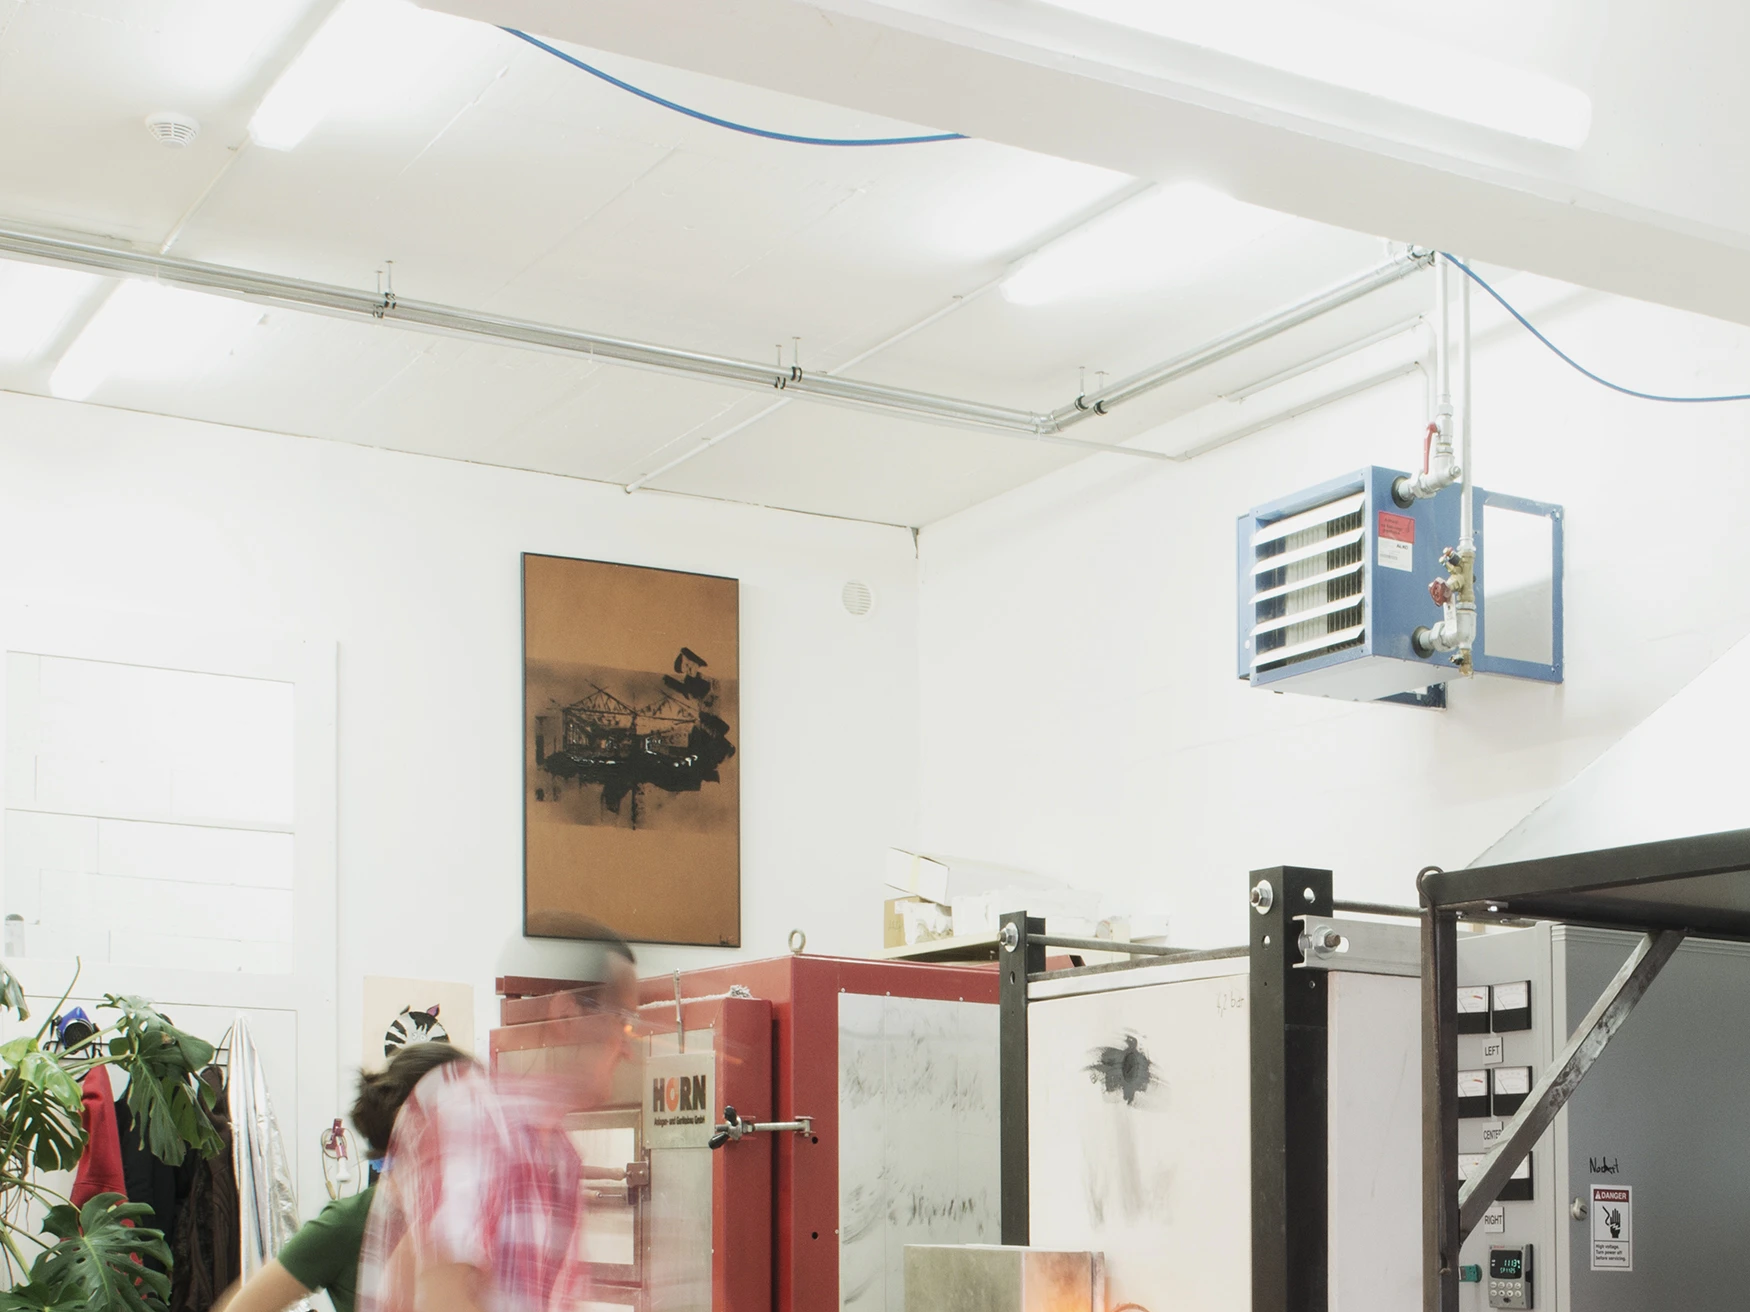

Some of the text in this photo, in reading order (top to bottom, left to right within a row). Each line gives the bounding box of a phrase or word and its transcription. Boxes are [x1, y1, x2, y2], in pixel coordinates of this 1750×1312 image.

[1485, 1045, 1500, 1056] LEFT
[653, 1075, 706, 1112] HORN
[1601, 1191, 1627, 1200] DANGER
[1484, 1214, 1502, 1225] RIGHT
